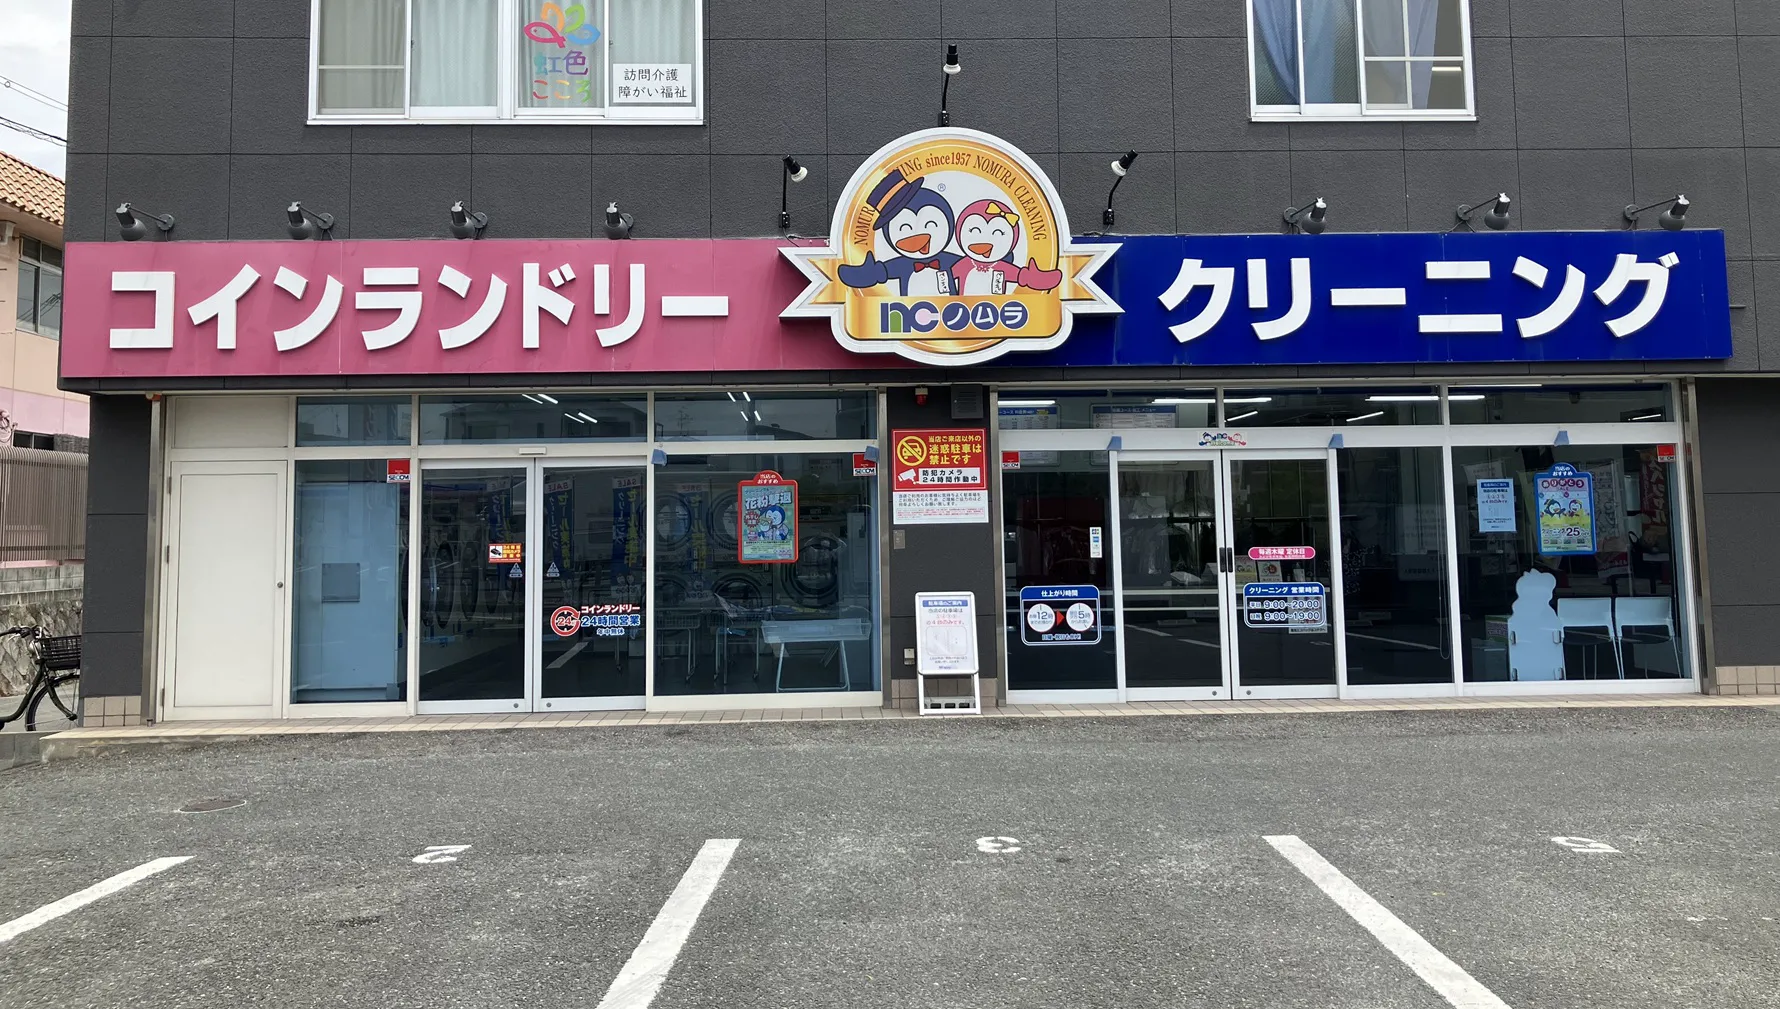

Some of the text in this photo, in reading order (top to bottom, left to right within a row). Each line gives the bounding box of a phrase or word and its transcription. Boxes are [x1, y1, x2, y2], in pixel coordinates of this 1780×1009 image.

[533, 50, 589, 76] 虹色
[624, 68, 679, 82] 訪問介護
[533, 79, 592, 103] こころ
[618, 86, 688, 99] 障がい福祉
[854, 151, 1047, 245] NOMUR ING since1957 NOMURA CLEANING
[1157, 251, 1681, 343] クリーニング
[109, 262, 729, 352] コインランドリー
[880, 300, 1029, 334] nc ノムラ
[929, 444, 982, 454] 迷惑駐車は
[929, 455, 971, 465] 禁止です
[1566, 527, 1580, 537] 25
[581, 604, 640, 613] コインランドリー
[581, 614, 641, 627] 24時間営業
[974, 836, 1021, 854] 3
